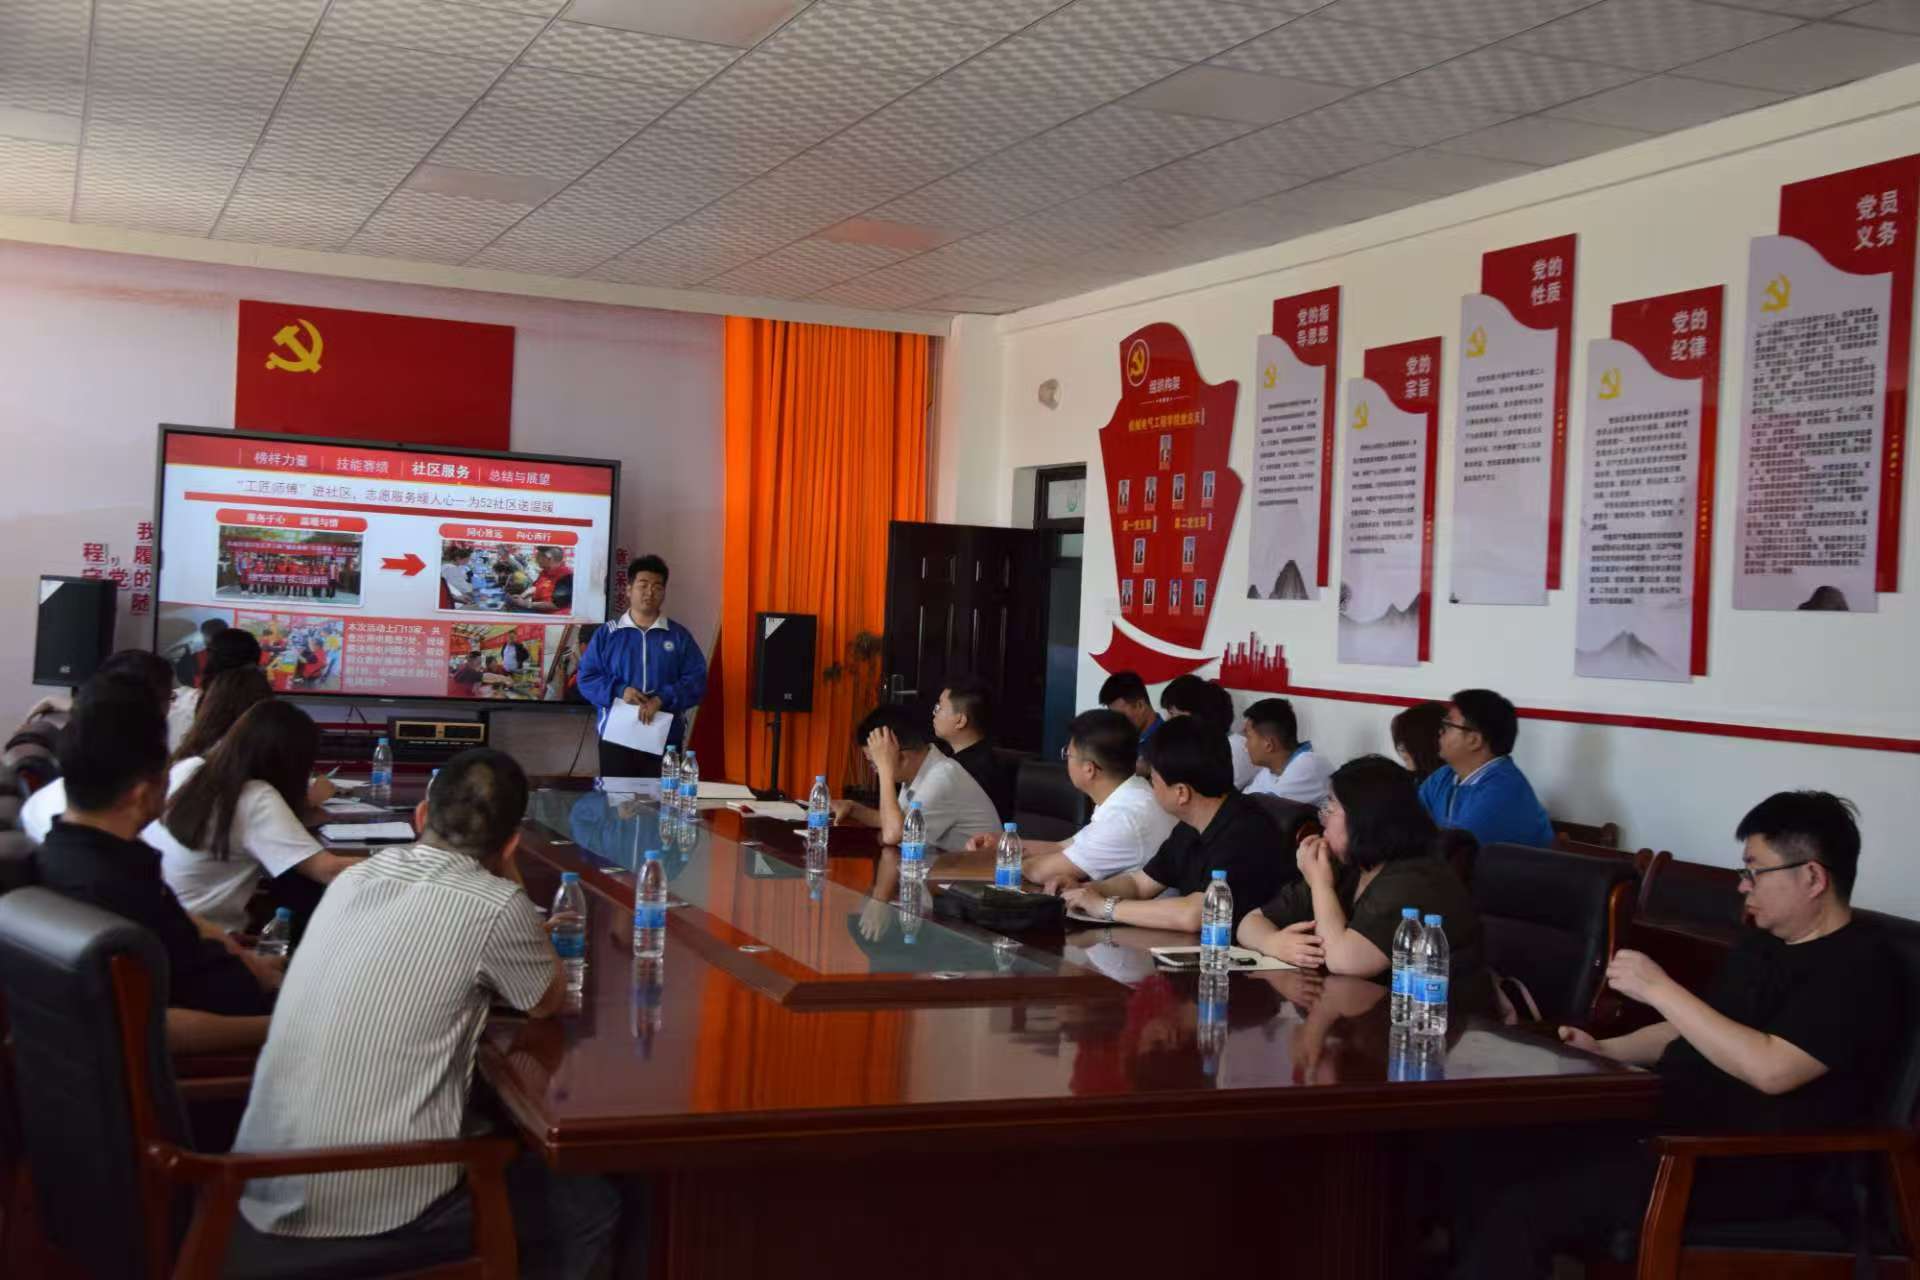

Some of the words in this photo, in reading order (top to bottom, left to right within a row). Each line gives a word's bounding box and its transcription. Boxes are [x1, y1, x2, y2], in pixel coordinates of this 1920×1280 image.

[1855, 188, 1898, 220] 党员
[1853, 221, 1897, 251] 义务
[1532, 256, 1563, 281] 党的
[1530, 282, 1562, 306] 性质
[1297, 304, 1330, 327] 党的指
[1671, 307, 1707, 335] 党的
[1670, 336, 1706, 361] 纪律
[1405, 354, 1432, 376] 党的
[254, 451, 309, 469] 榜样力量
[411, 461, 470, 480] 社区服务
[489, 469, 551, 486] 总结与展望
[137, 522, 154, 541] 我
